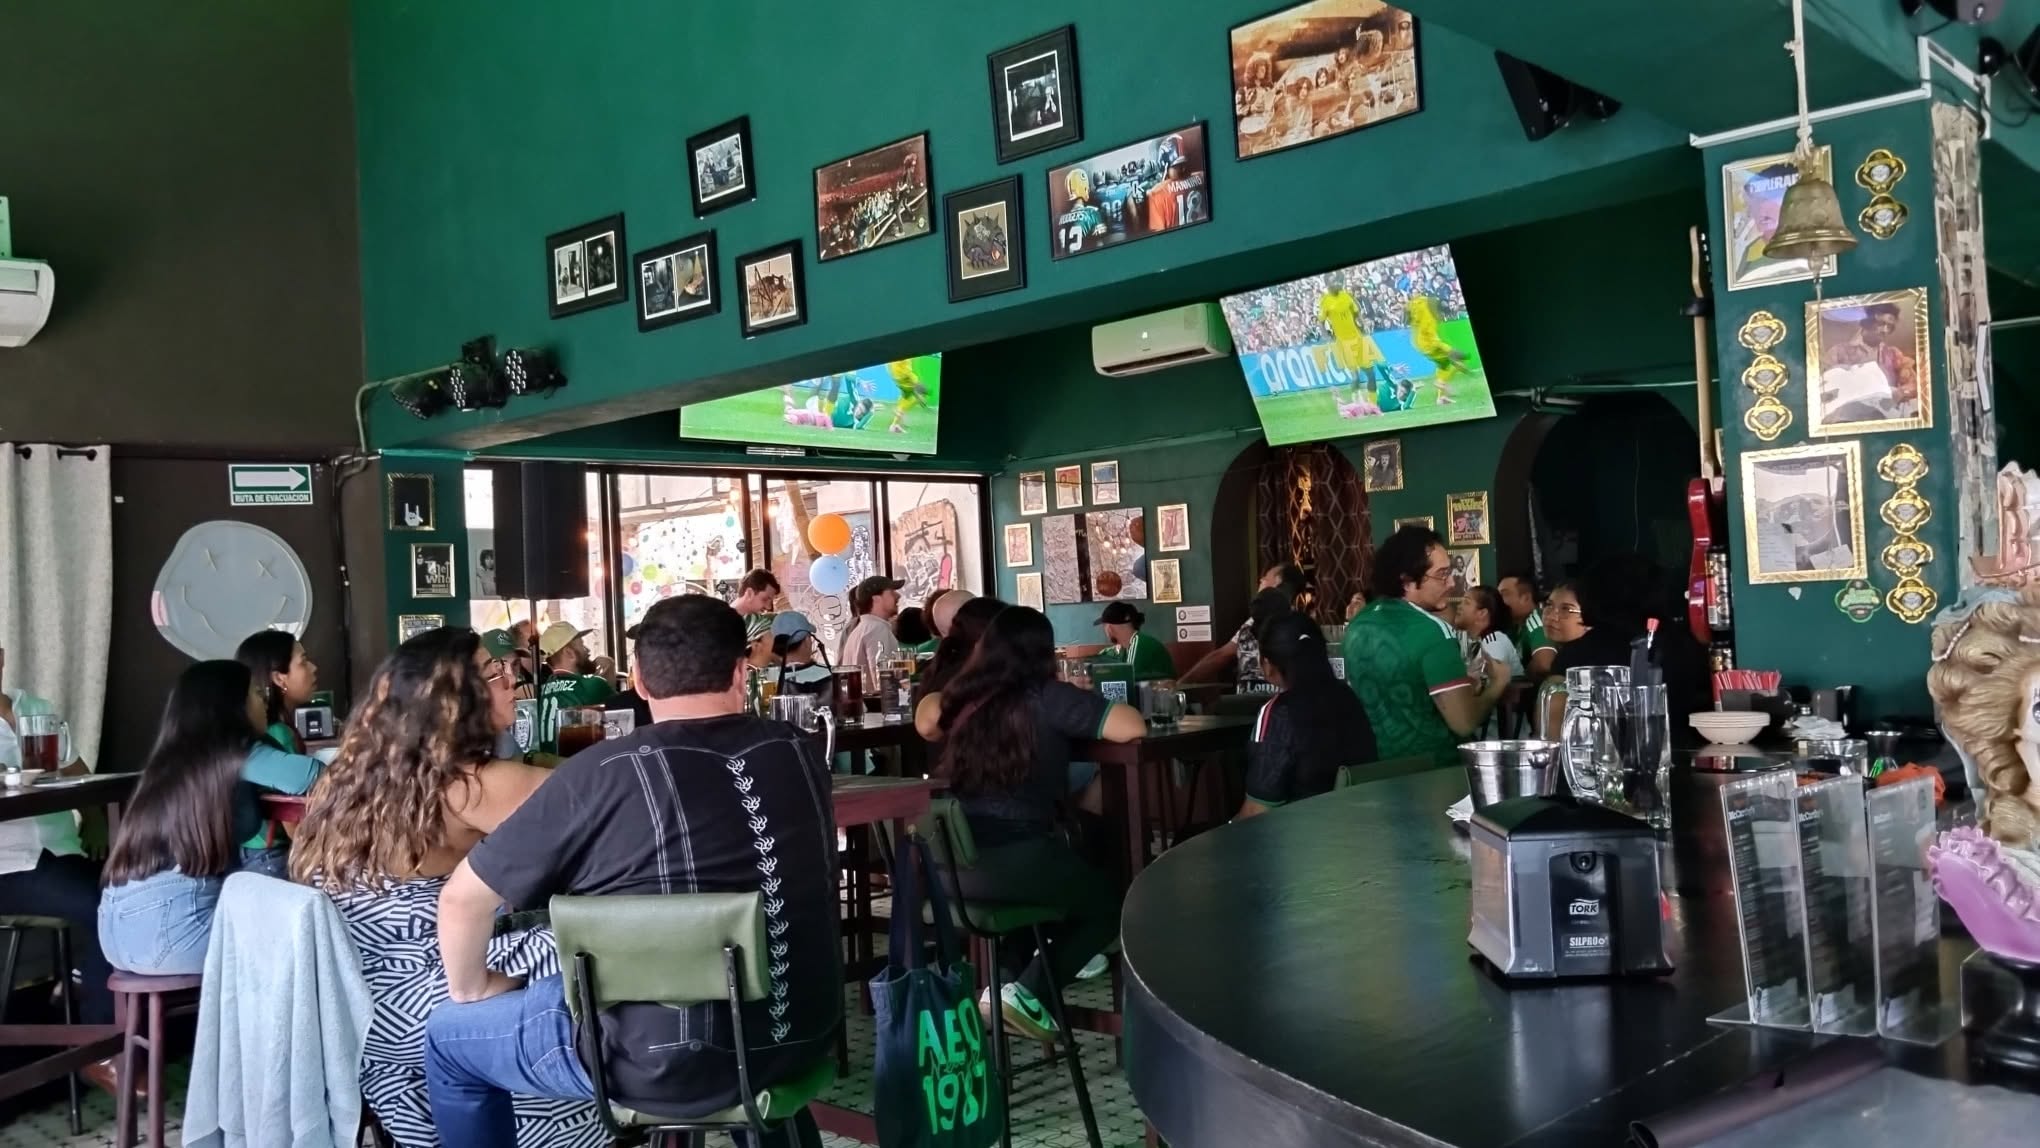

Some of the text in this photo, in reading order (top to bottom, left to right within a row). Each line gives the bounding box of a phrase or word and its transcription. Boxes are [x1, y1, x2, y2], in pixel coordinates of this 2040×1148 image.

[1167, 175, 1203, 194] MANNING
[234, 494, 254, 503] RUTA
[1571, 904, 1598, 913] TORK
